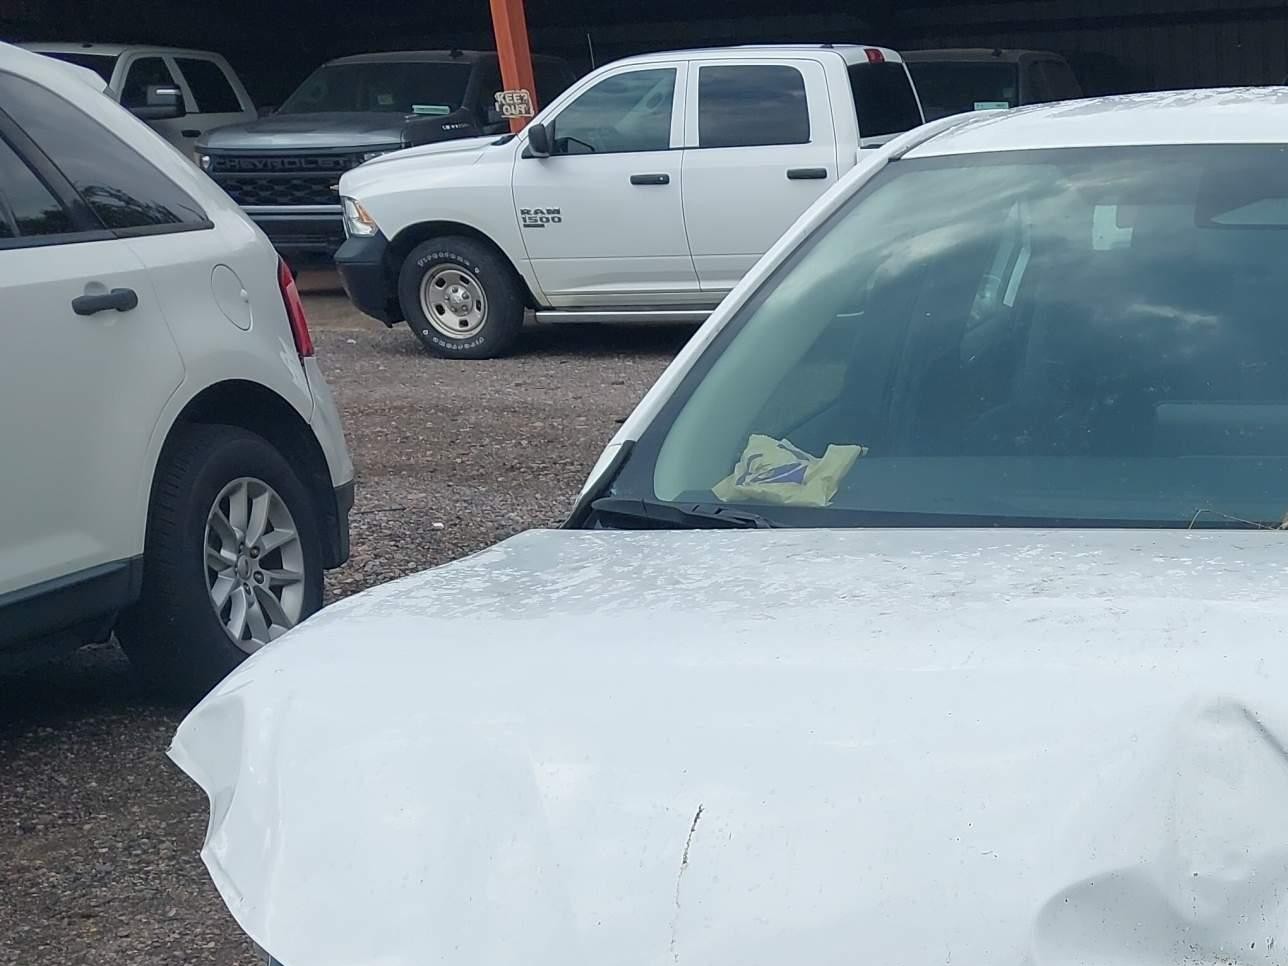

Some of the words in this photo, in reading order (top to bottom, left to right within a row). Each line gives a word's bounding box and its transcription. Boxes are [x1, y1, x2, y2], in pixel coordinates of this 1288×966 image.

[502, 104, 528, 115] OUT
[214, 157, 348, 169] CHEVROLET
[520, 208, 561, 216] RAM
[521, 216, 562, 224] 1500
